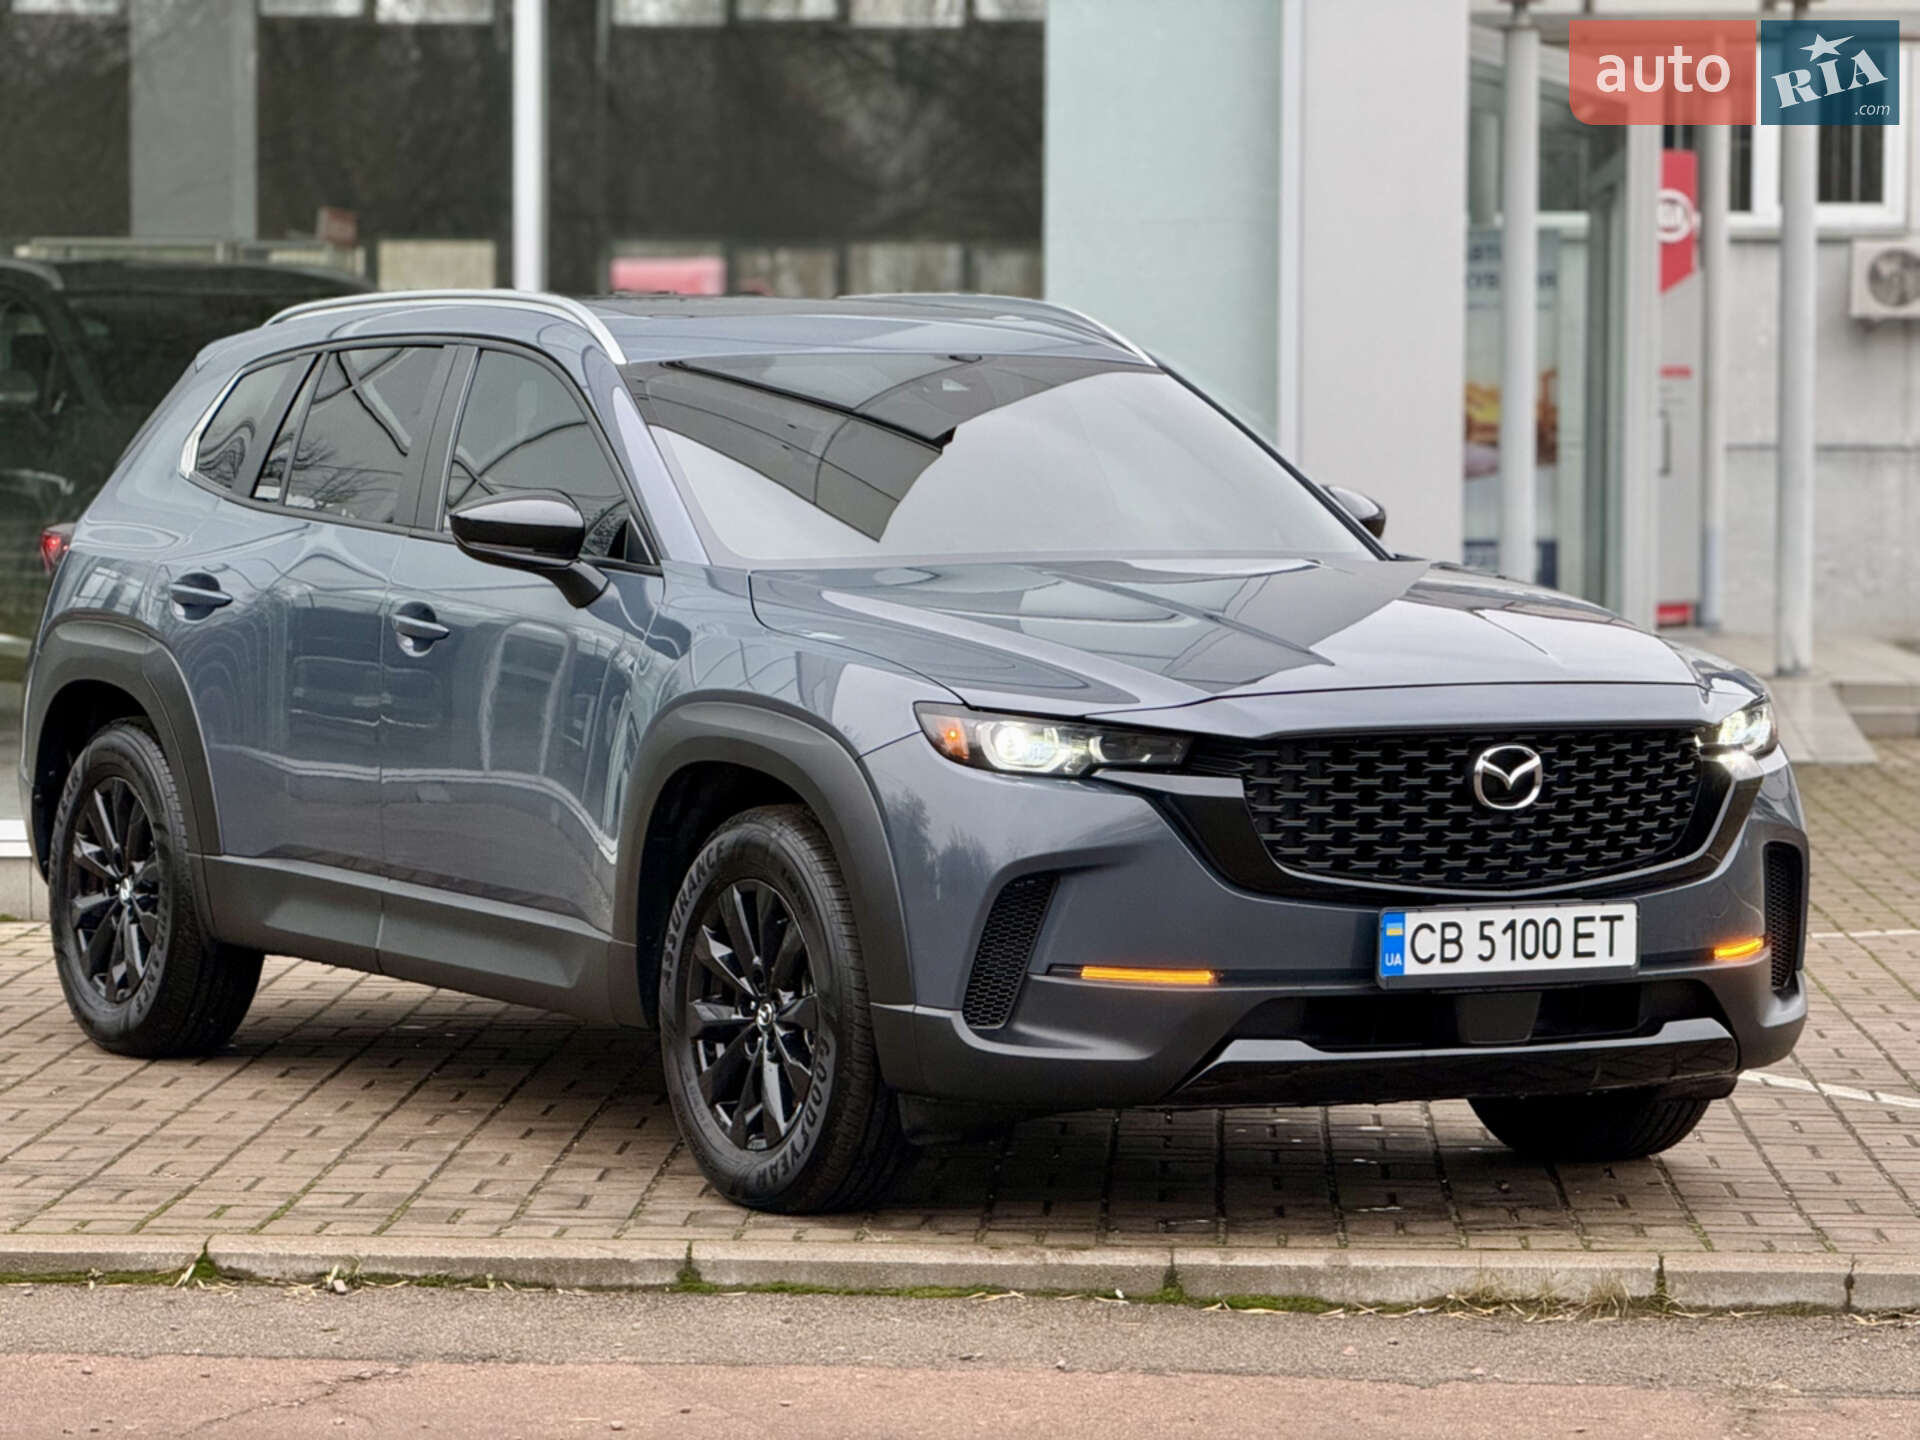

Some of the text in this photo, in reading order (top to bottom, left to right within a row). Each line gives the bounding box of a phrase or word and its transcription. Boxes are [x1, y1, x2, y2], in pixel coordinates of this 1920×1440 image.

[662, 839, 726, 993] ASSURANCE
[1385, 952, 1402, 967] UA
[1410, 915, 1624, 965] CB 5100 ET
[755, 1034, 832, 1190] GOODYEAR
